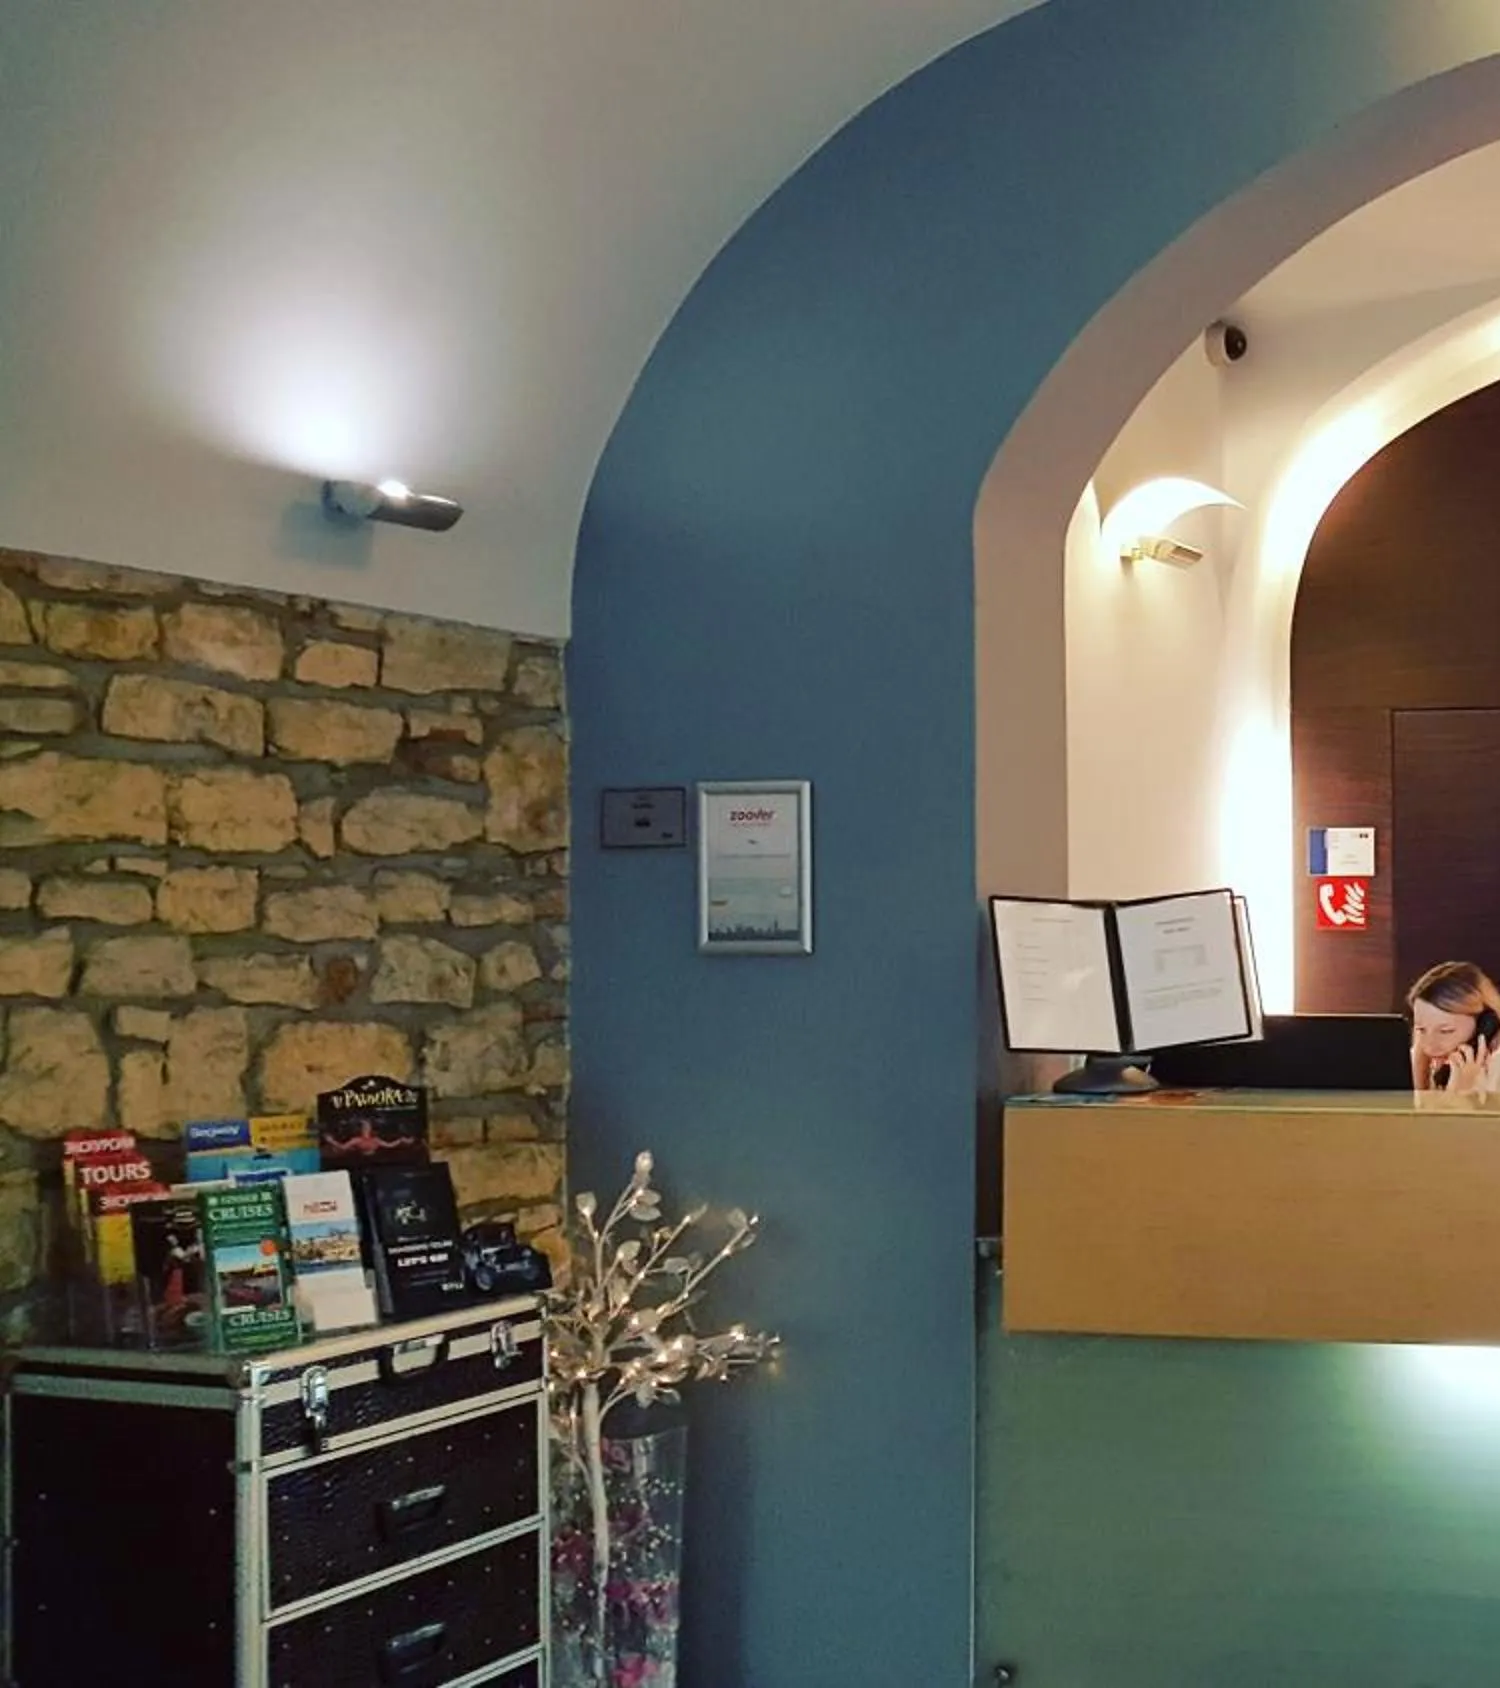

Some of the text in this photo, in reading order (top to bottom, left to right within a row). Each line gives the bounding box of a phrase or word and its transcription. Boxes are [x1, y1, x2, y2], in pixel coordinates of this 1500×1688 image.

[730, 808, 776, 822] zoover
[80, 1161, 151, 1185] TOURS
[209, 1203, 273, 1221] CRUISES
